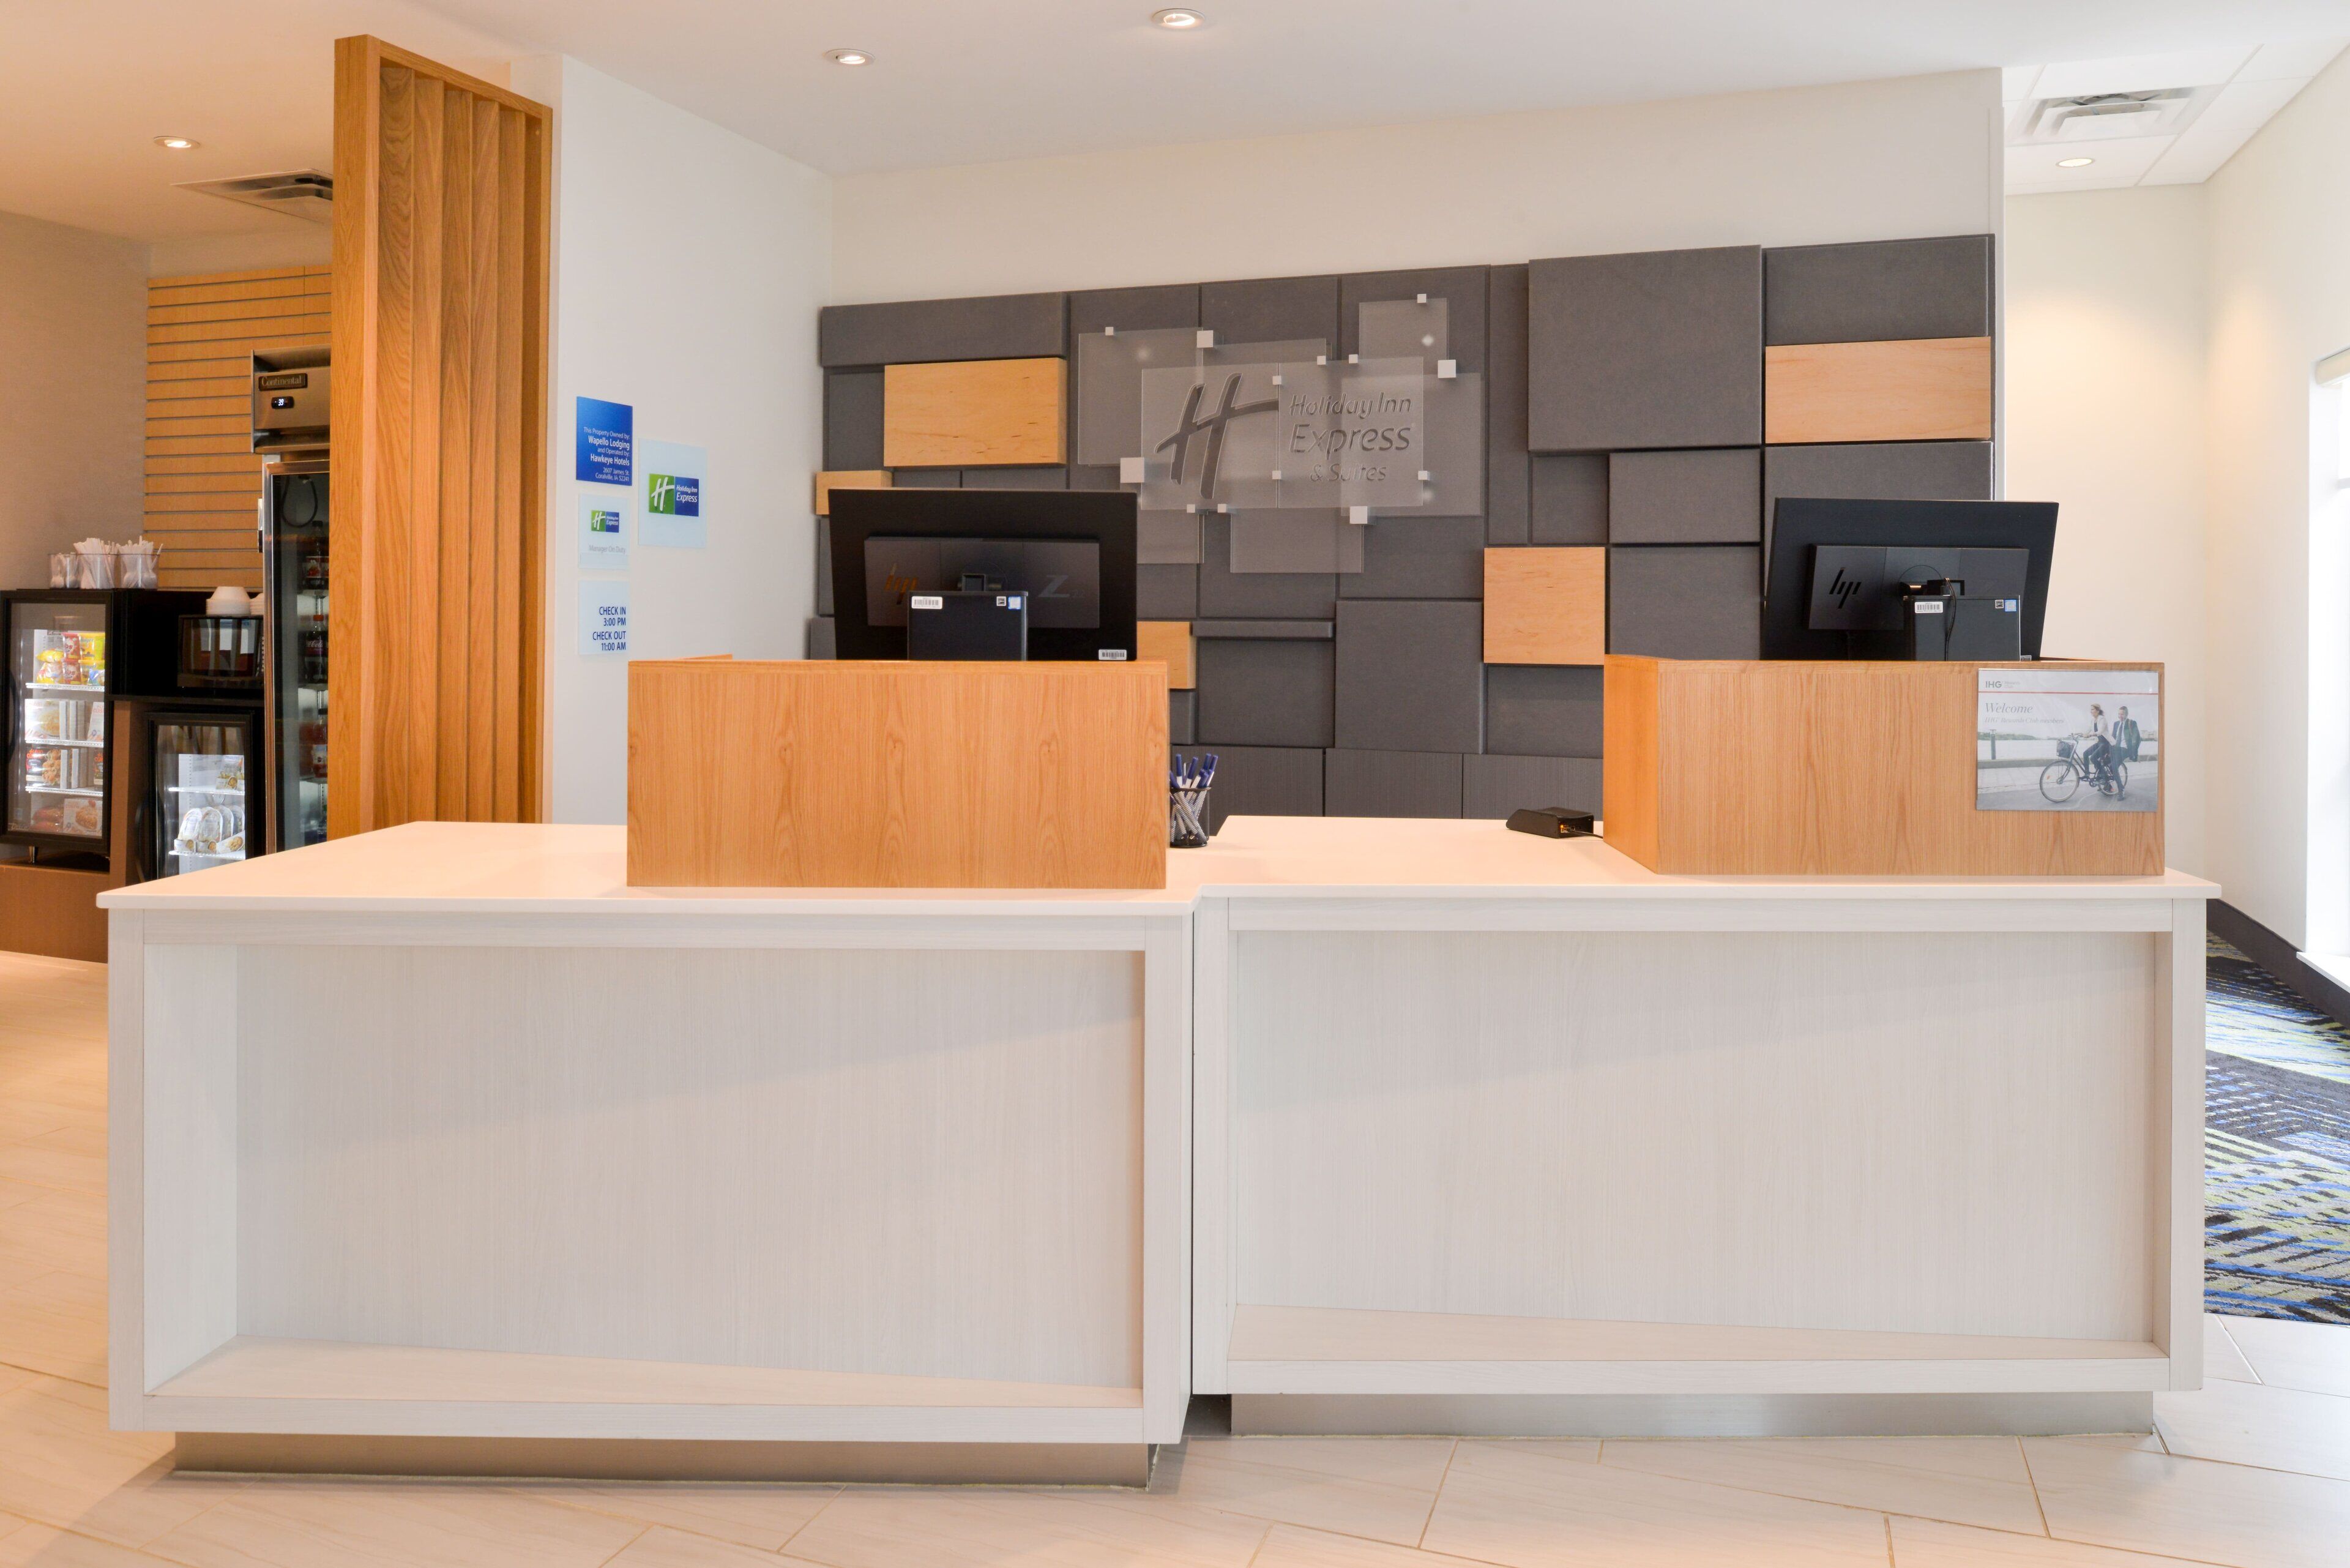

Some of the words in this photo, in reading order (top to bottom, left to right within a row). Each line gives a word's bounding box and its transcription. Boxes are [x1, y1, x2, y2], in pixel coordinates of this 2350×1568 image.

[261, 375, 302, 386] Continental
[1289, 392, 1373, 419] Holiday
[1378, 391, 1411, 413] Inn
[592, 428, 609, 438] Property
[588, 435, 609, 446] Wapello
[610, 438, 630, 450] Lodging
[1289, 423, 1411, 460] Express
[591, 454, 613, 465] Hawkeye
[614, 457, 630, 466] Hotels
[1310, 464, 1323, 482] &
[1327, 463, 1387, 482] Suites
[676, 484, 692, 494] Holiday
[676, 492, 698, 504] Express
[589, 545, 608, 553] Manager
[616, 546, 625, 554] Duty
[599, 606, 619, 615] CHECK
[620, 606, 626, 615] IN
[603, 618, 616, 626] 3:00
[617, 617, 626, 626] PM
[592, 631, 612, 640] CHECK
[614, 631, 626, 640] OUT
[602, 642, 615, 651] 11:00
[616, 642, 626, 651] AM
[1985, 702, 2033, 713] Welcome
